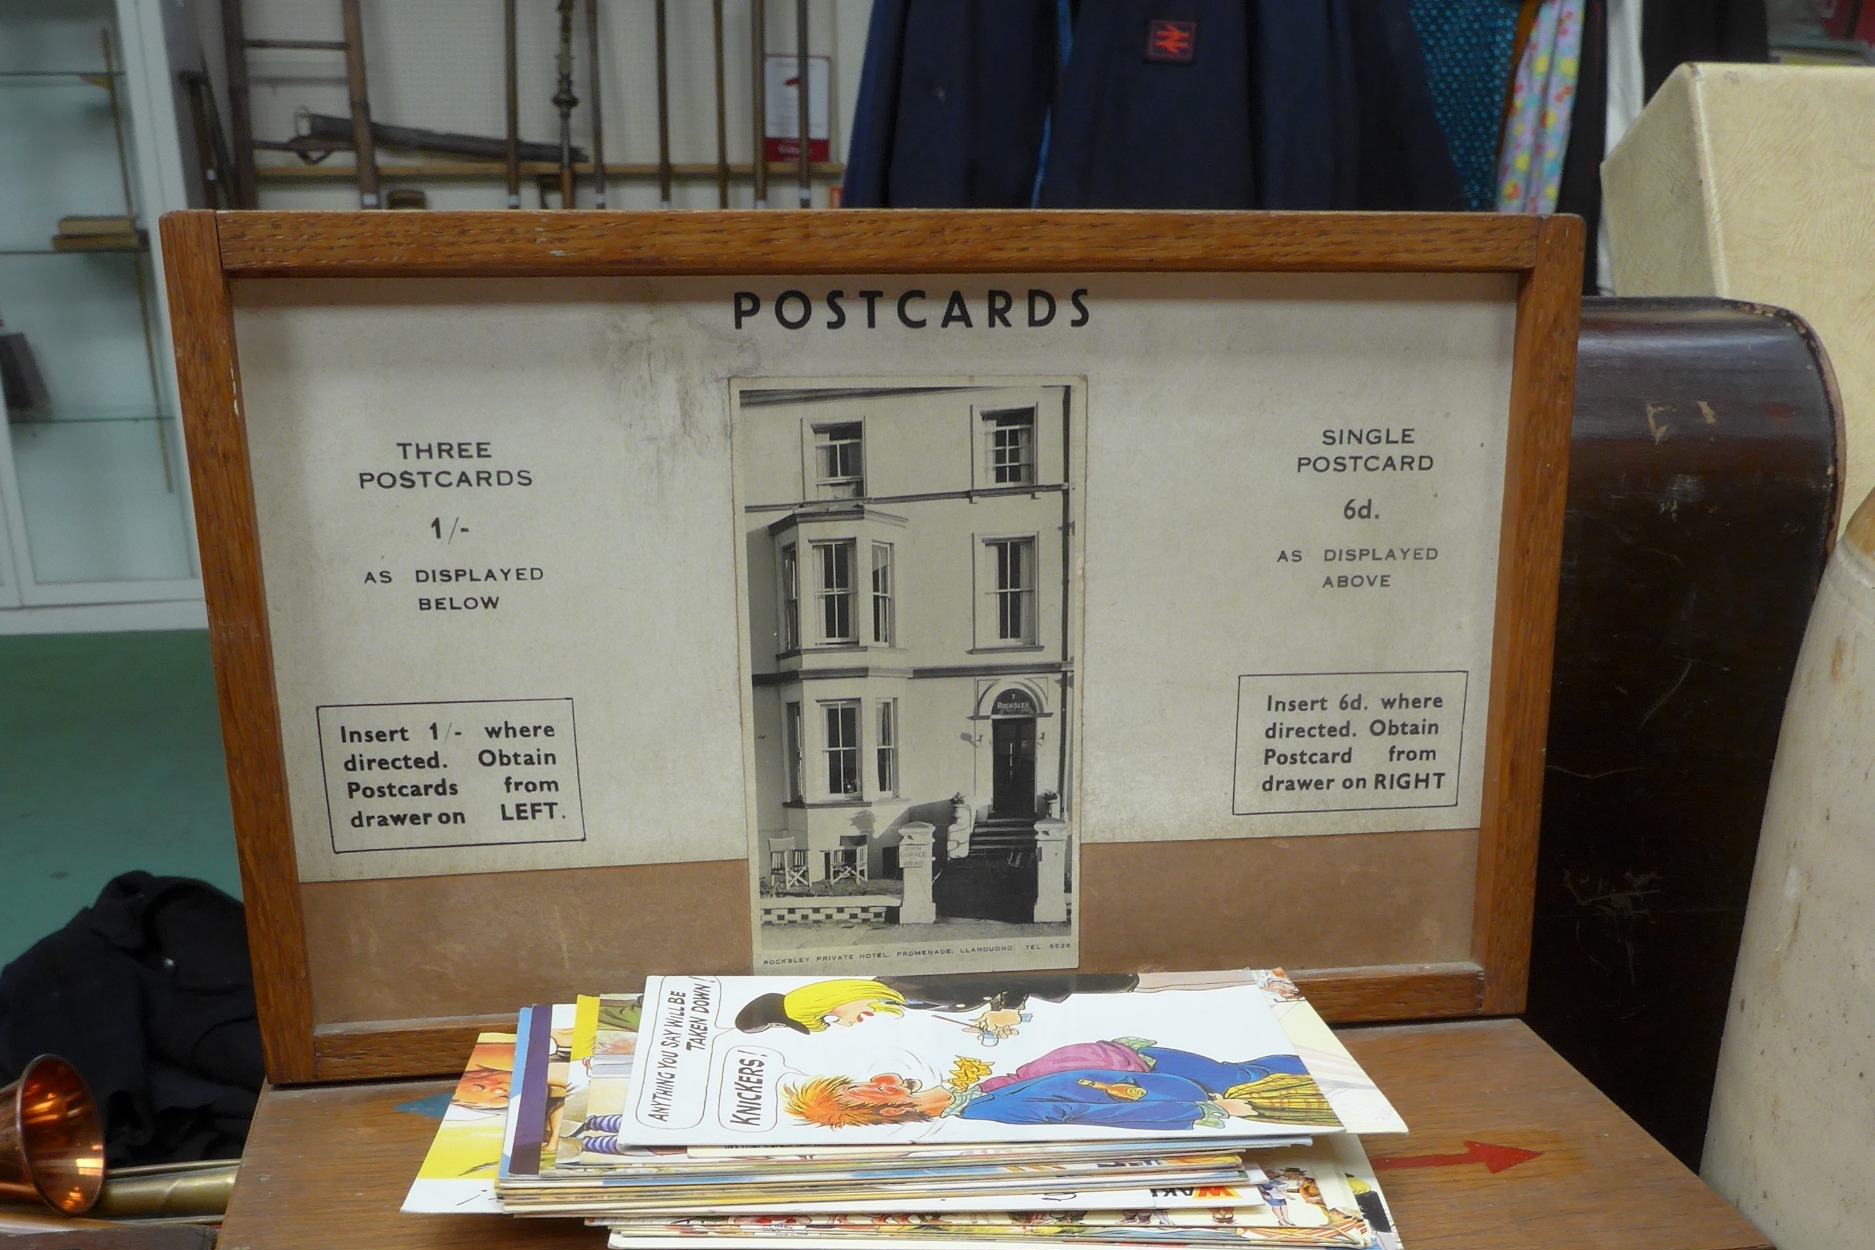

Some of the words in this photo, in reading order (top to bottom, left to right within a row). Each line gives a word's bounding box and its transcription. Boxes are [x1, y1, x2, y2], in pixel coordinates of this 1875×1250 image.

[733, 288, 1090, 330] POSTCARDS
[1321, 428, 1416, 446] SINGLE
[396, 441, 493, 460] THREE
[1297, 455, 1434, 473] POSTCARD
[358, 470, 533, 489] POSTCARDS
[1343, 498, 1380, 520] 6d.
[430, 517, 470, 545] 1/-
[1276, 549, 1303, 563] AS
[1323, 547, 1439, 562] DISPLAYED
[364, 570, 393, 584] AS
[415, 567, 544, 583] DISPLAYED
[1322, 574, 1391, 589] ABOVE
[418, 596, 500, 611] BELOW
[1266, 694, 1328, 712] Insert
[1338, 693, 1369, 711] 6d.
[1381, 692, 1443, 710] where
[340, 725, 410, 744] Insert
[428, 722, 463, 745] 1/-
[484, 721, 556, 740] where
[1264, 721, 1357, 739] directed.
[1369, 718, 1440, 737] Obtain
[343, 751, 449, 772] directed.
[477, 749, 557, 768] Obtain
[1263, 747, 1353, 765] Postcard
[1388, 744, 1437, 763] from
[347, 779, 459, 799] Postcards
[503, 776, 560, 795] from
[1261, 775, 1335, 792] drawer
[1341, 776, 1368, 791] on
[1373, 772, 1446, 790] RIGHT
[350, 808, 434, 828] drawer
[436, 813, 466, 826] on
[500, 802, 567, 821] LEFT.
[763, 956, 811, 966] ROCKSLEY
[816, 953, 855, 962] PRIVATE
[667, 990, 687, 1006] BE
[663, 1007, 686, 1028] WILL
[660, 1029, 682, 1048] SAY
[685, 1017, 709, 1051] TAKEN
[657, 1050, 680, 1070] YOU
[648, 1071, 678, 1123] ANYTHING
